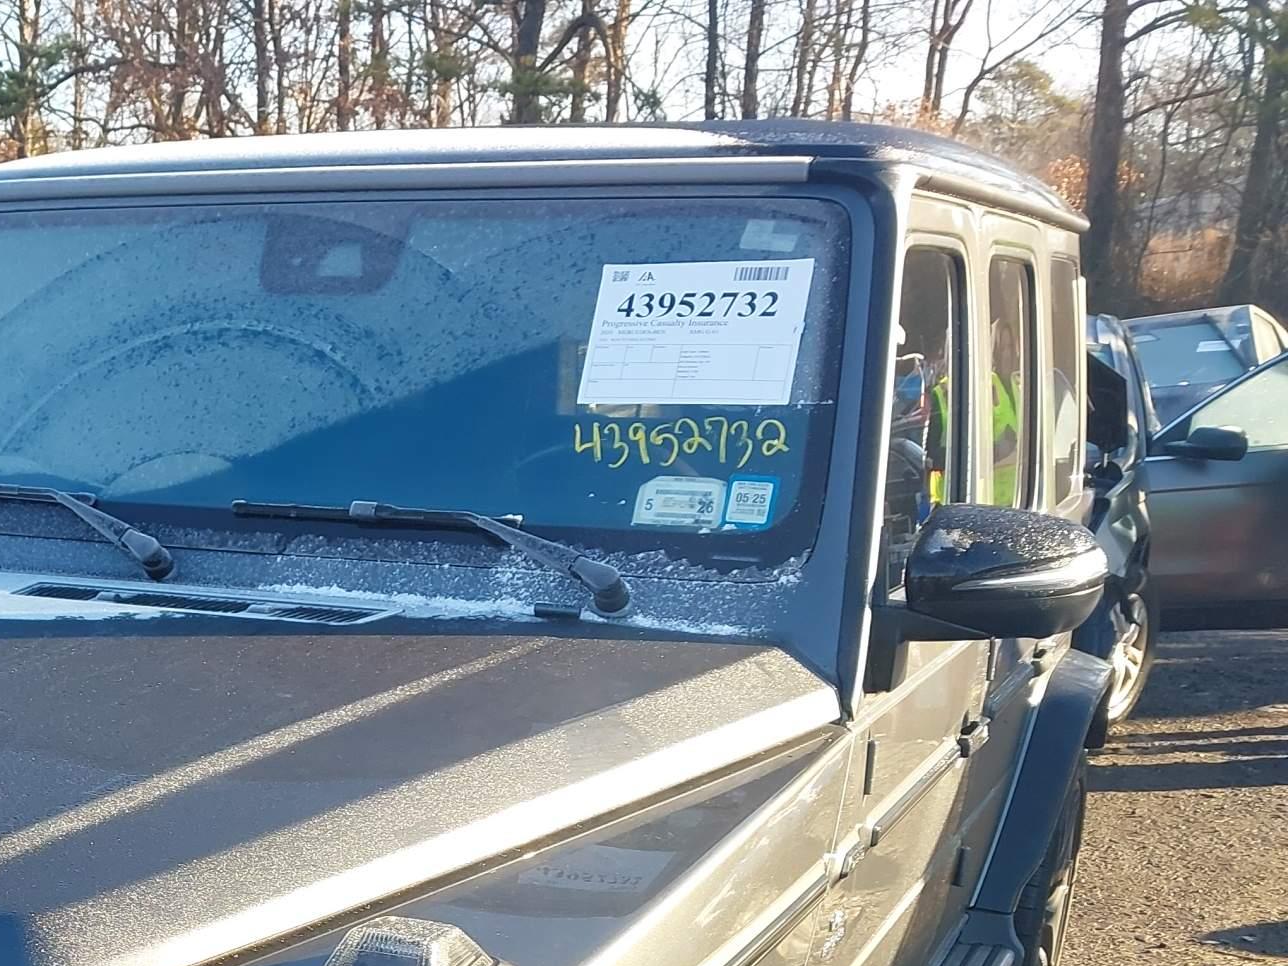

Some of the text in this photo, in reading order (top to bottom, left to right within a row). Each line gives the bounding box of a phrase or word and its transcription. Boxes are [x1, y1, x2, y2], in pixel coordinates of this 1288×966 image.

[617, 291, 779, 318] 43952732
[601, 318, 728, 329] Progressive Casualty Insurance
[574, 416, 790, 469] 43952732
[644, 498, 654, 511] 5
[696, 500, 715, 514] 26
[735, 492, 767, 504] 05 25
